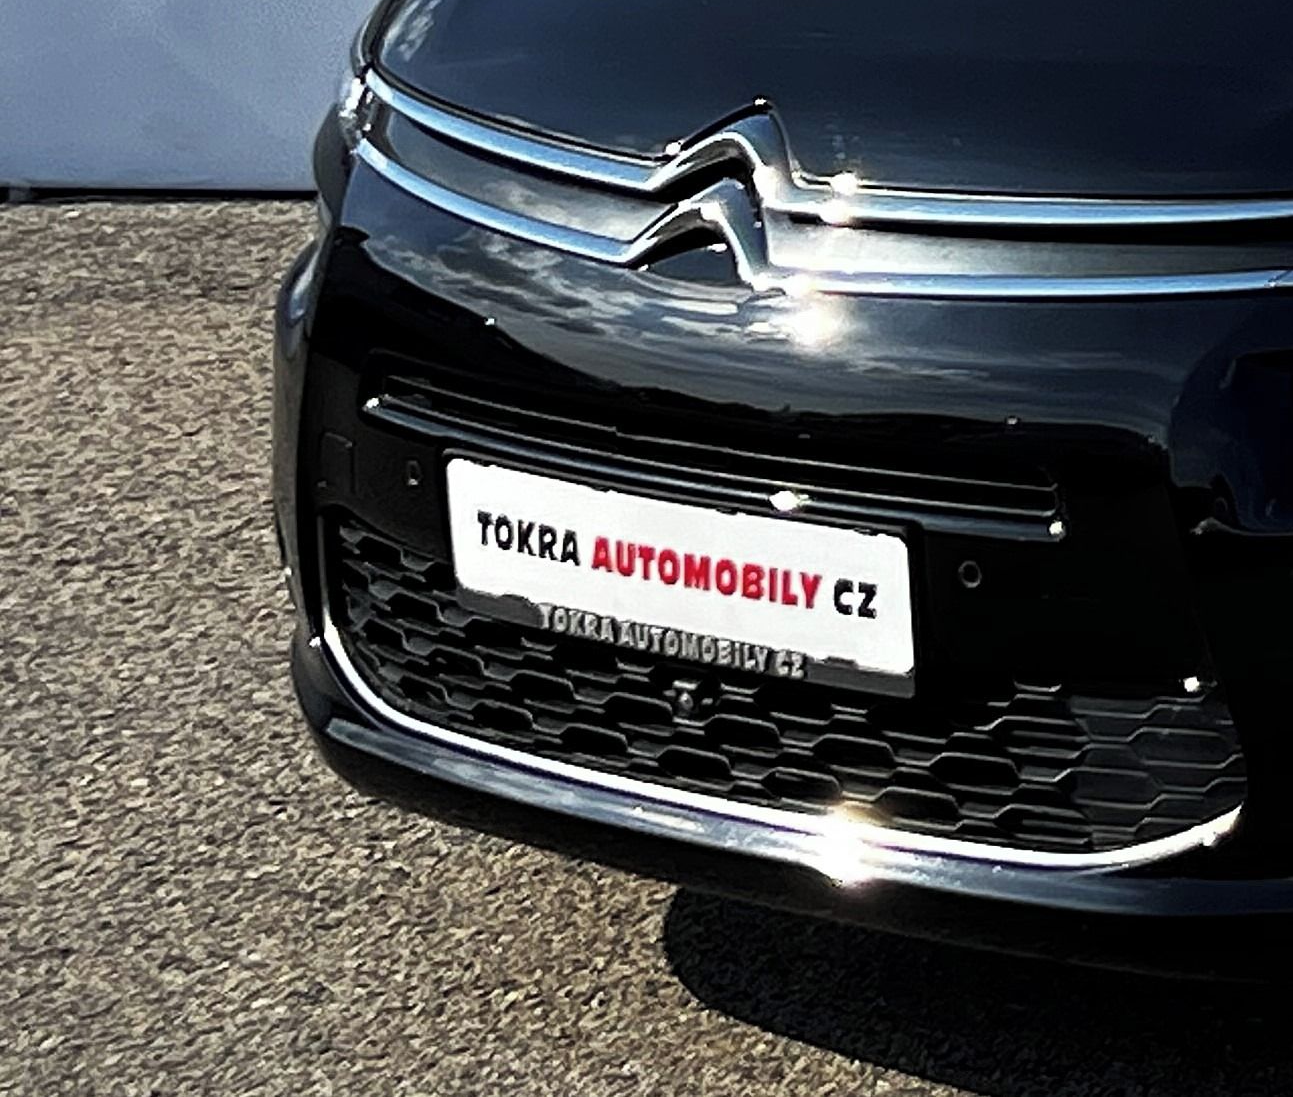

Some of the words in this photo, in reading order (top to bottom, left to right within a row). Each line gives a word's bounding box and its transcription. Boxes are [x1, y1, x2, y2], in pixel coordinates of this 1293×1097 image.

[477, 510, 580, 565] TOKRA
[592, 536, 823, 608] AUTOMOBILY
[833, 579, 877, 619] CZ
[538, 603, 615, 643] TOKRA
[617, 619, 769, 674] AUTOMOBILY
[775, 649, 806, 679] CZ
